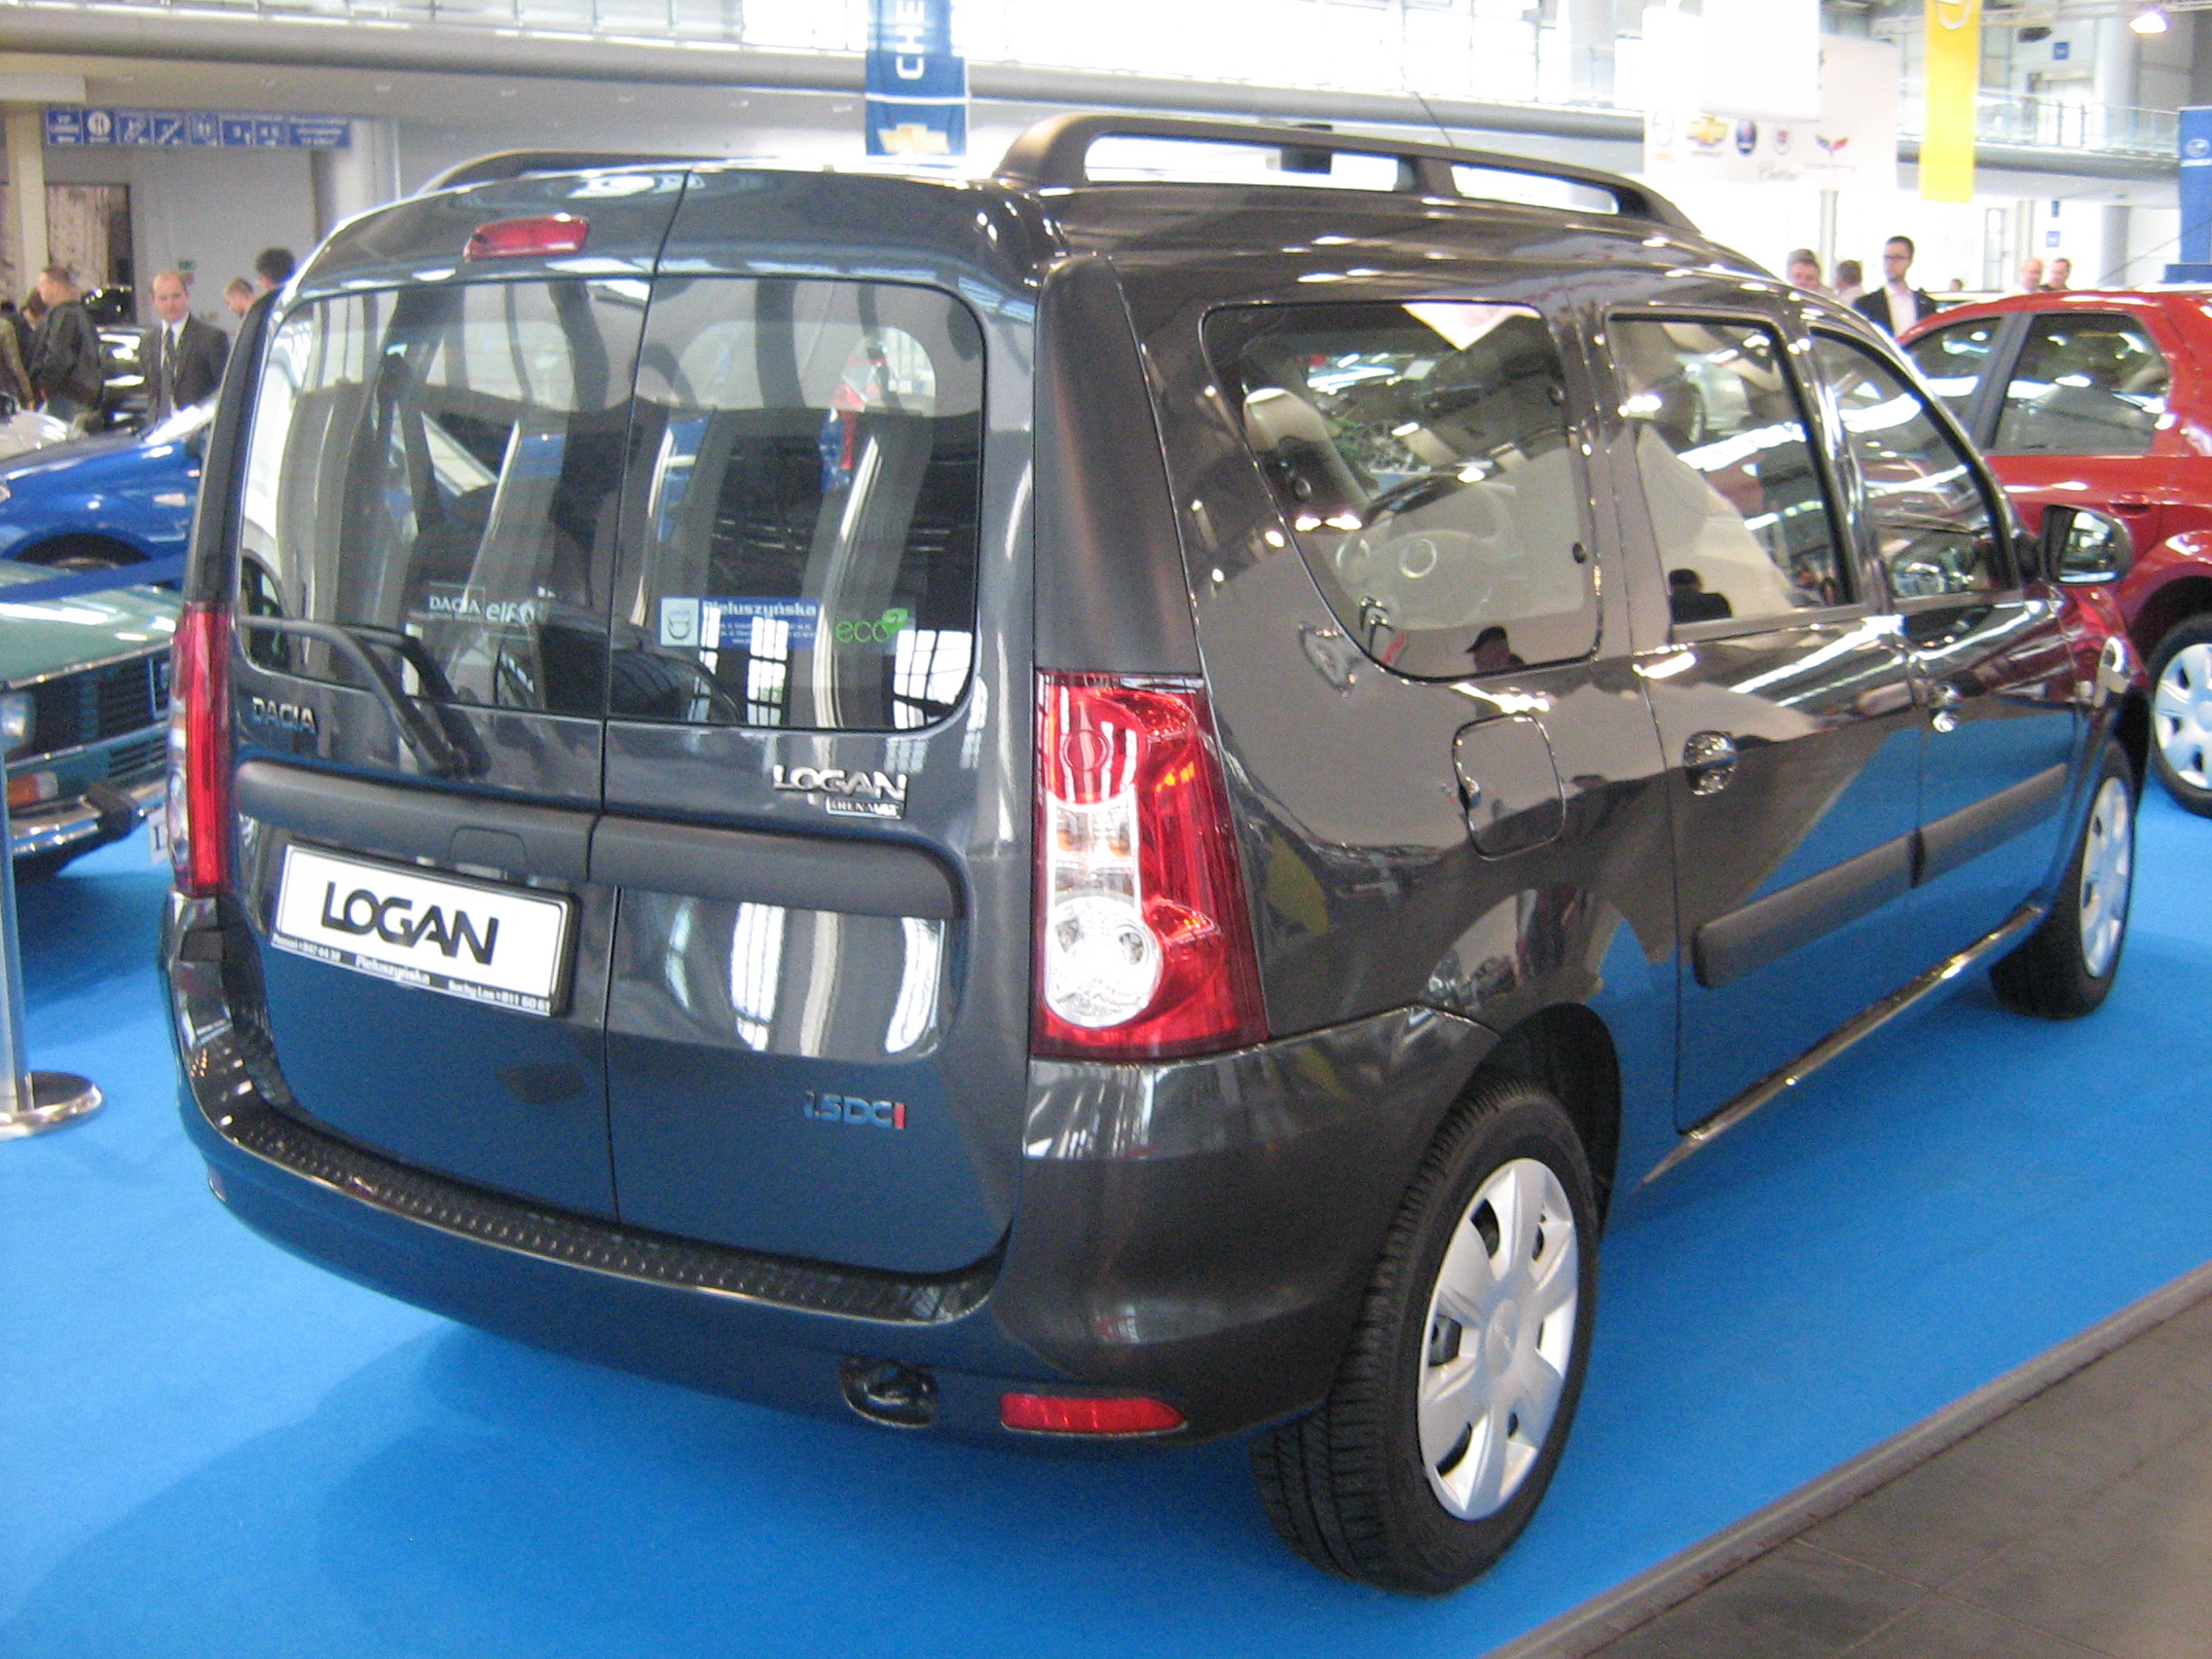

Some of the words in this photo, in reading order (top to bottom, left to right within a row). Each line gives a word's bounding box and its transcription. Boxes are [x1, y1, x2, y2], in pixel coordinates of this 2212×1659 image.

[252, 696, 316, 735] DACIA
[773, 763, 907, 800] LOGAN
[321, 880, 500, 967] LOGAN
